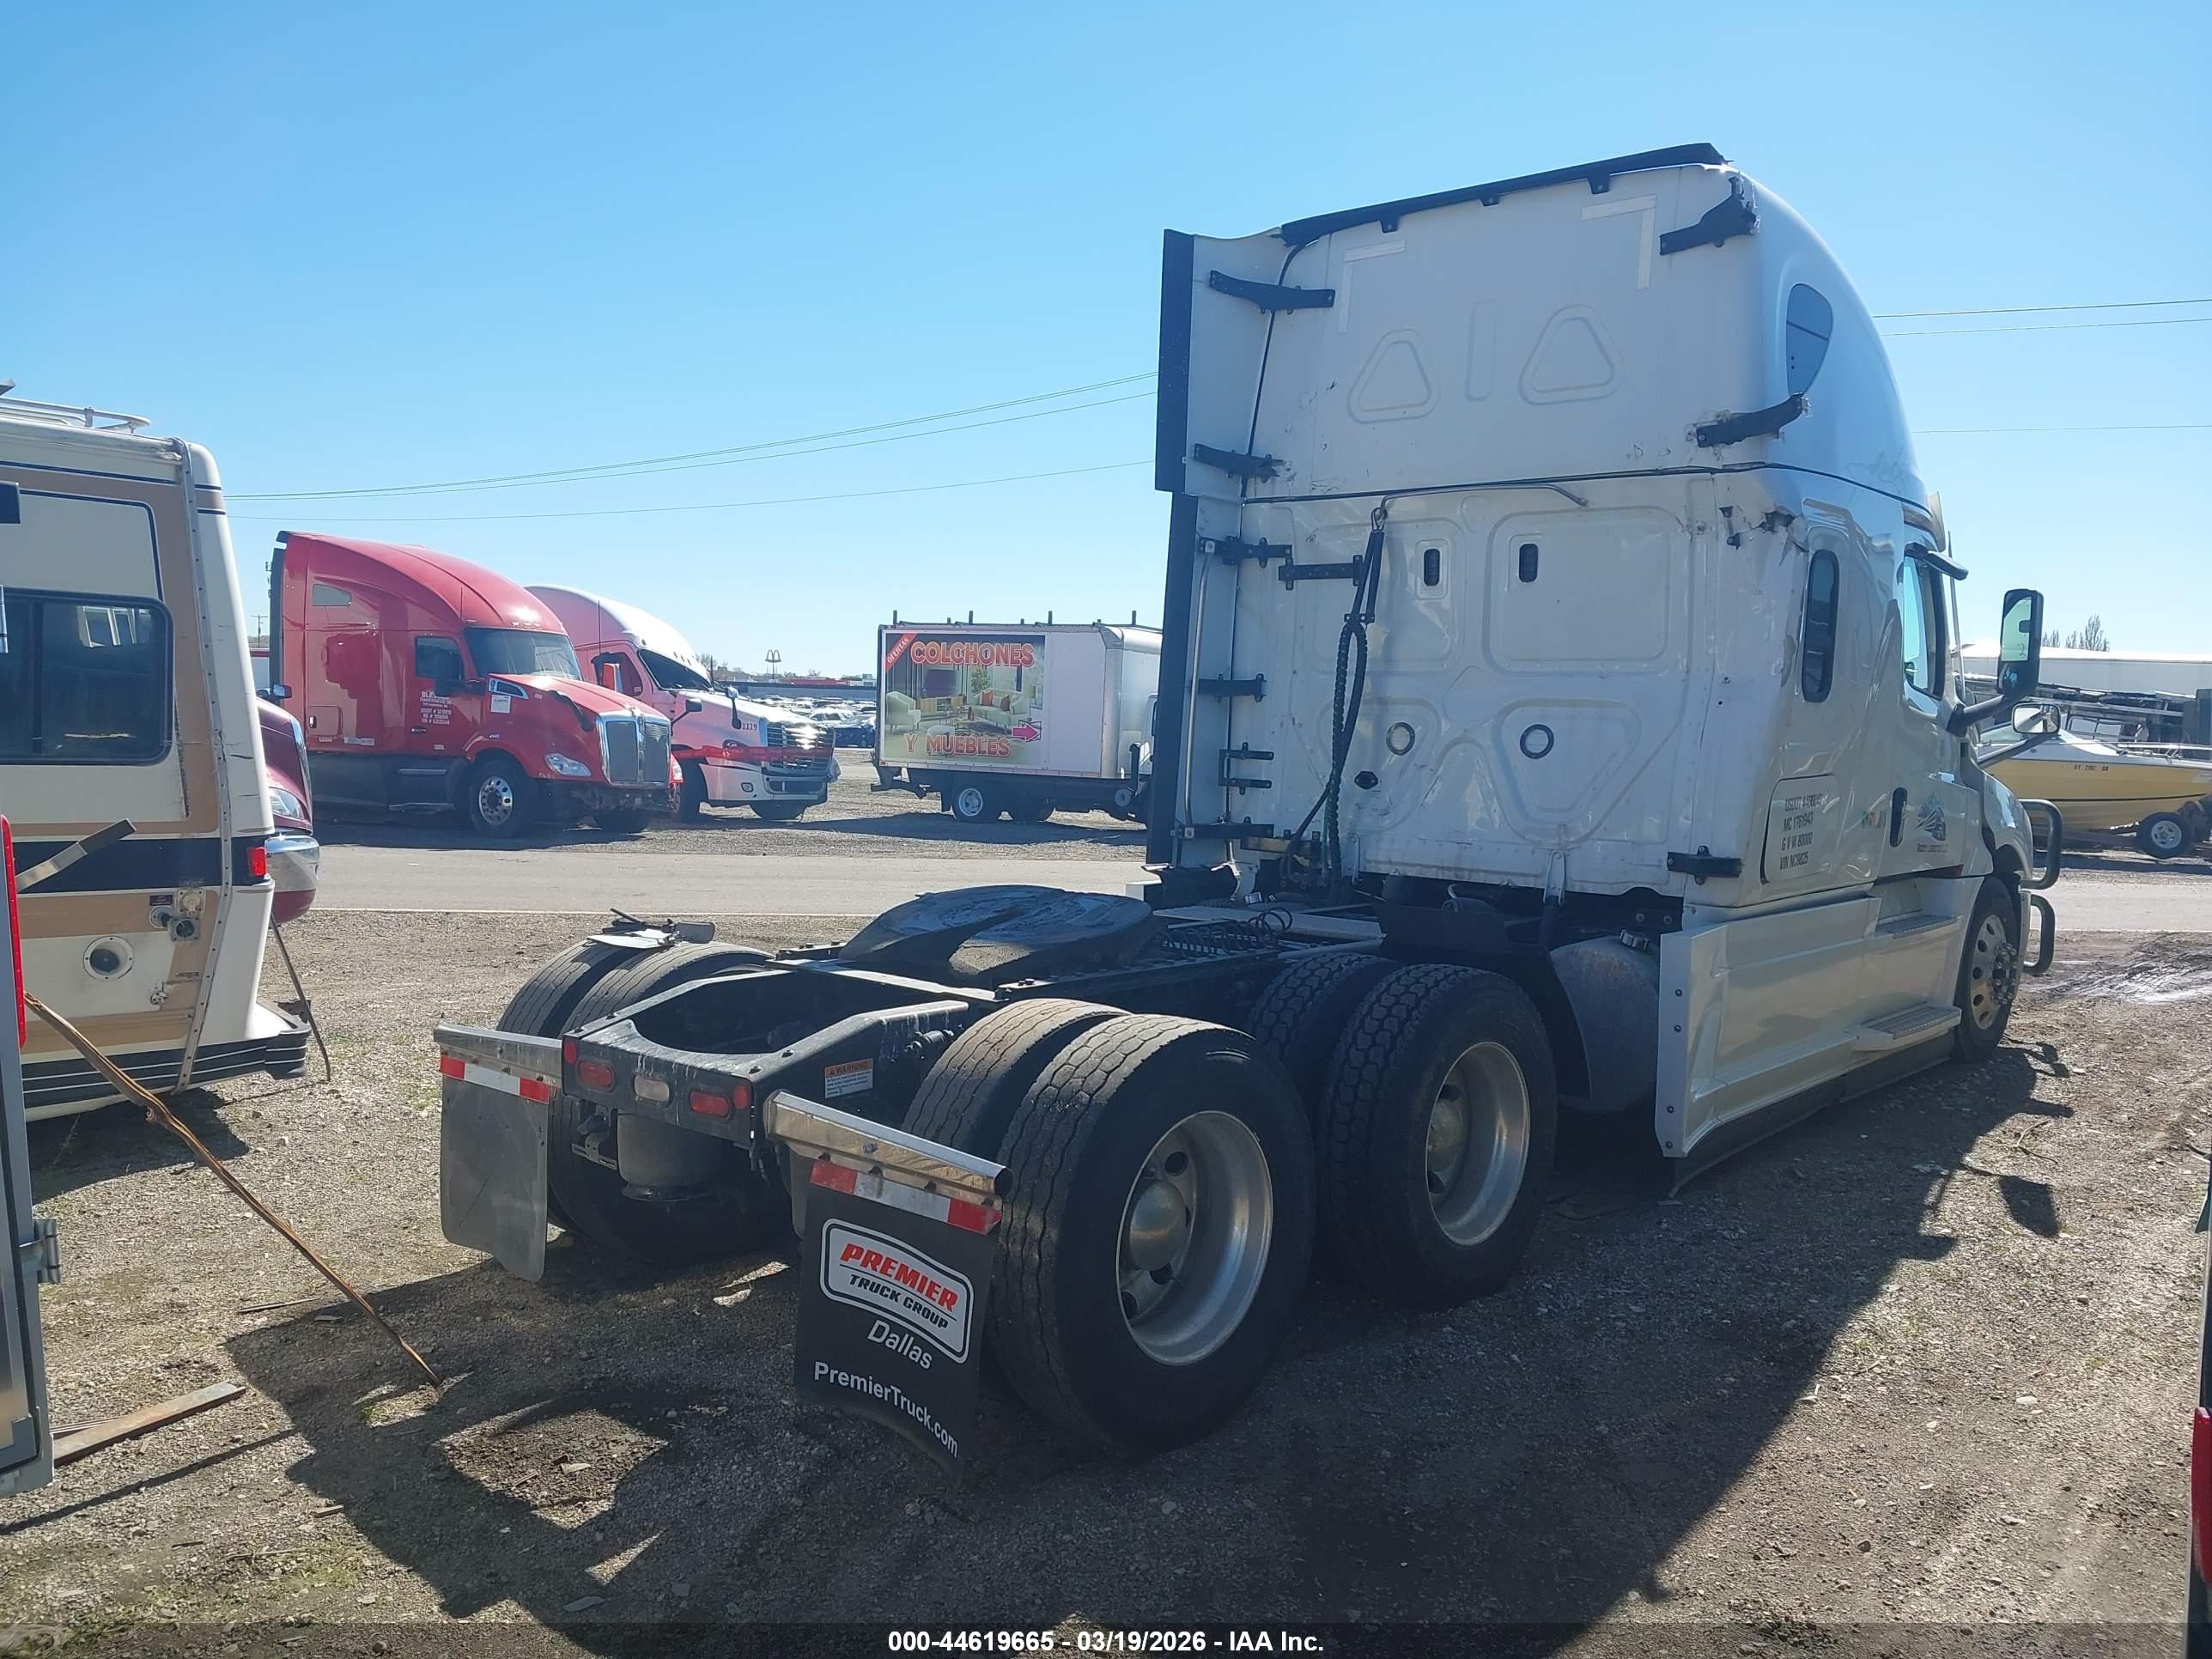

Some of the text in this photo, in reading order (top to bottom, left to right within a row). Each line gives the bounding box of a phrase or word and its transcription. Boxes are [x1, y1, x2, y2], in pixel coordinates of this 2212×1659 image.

[911, 641, 1035, 667] COLCHONES
[904, 733, 1011, 757] Y MUEBLES
[1785, 796, 1802, 811] USDOT
[1784, 817, 1793, 831] MC
[1780, 856, 1789, 870] VIN
[836, 1061, 869, 1074] WARNING
[840, 1243, 958, 1312] PREMIER
[849, 1274, 949, 1328] TRUCK GROUP
[867, 1320, 933, 1369] Dallas
[814, 1361, 959, 1458] PremierTruck.com
